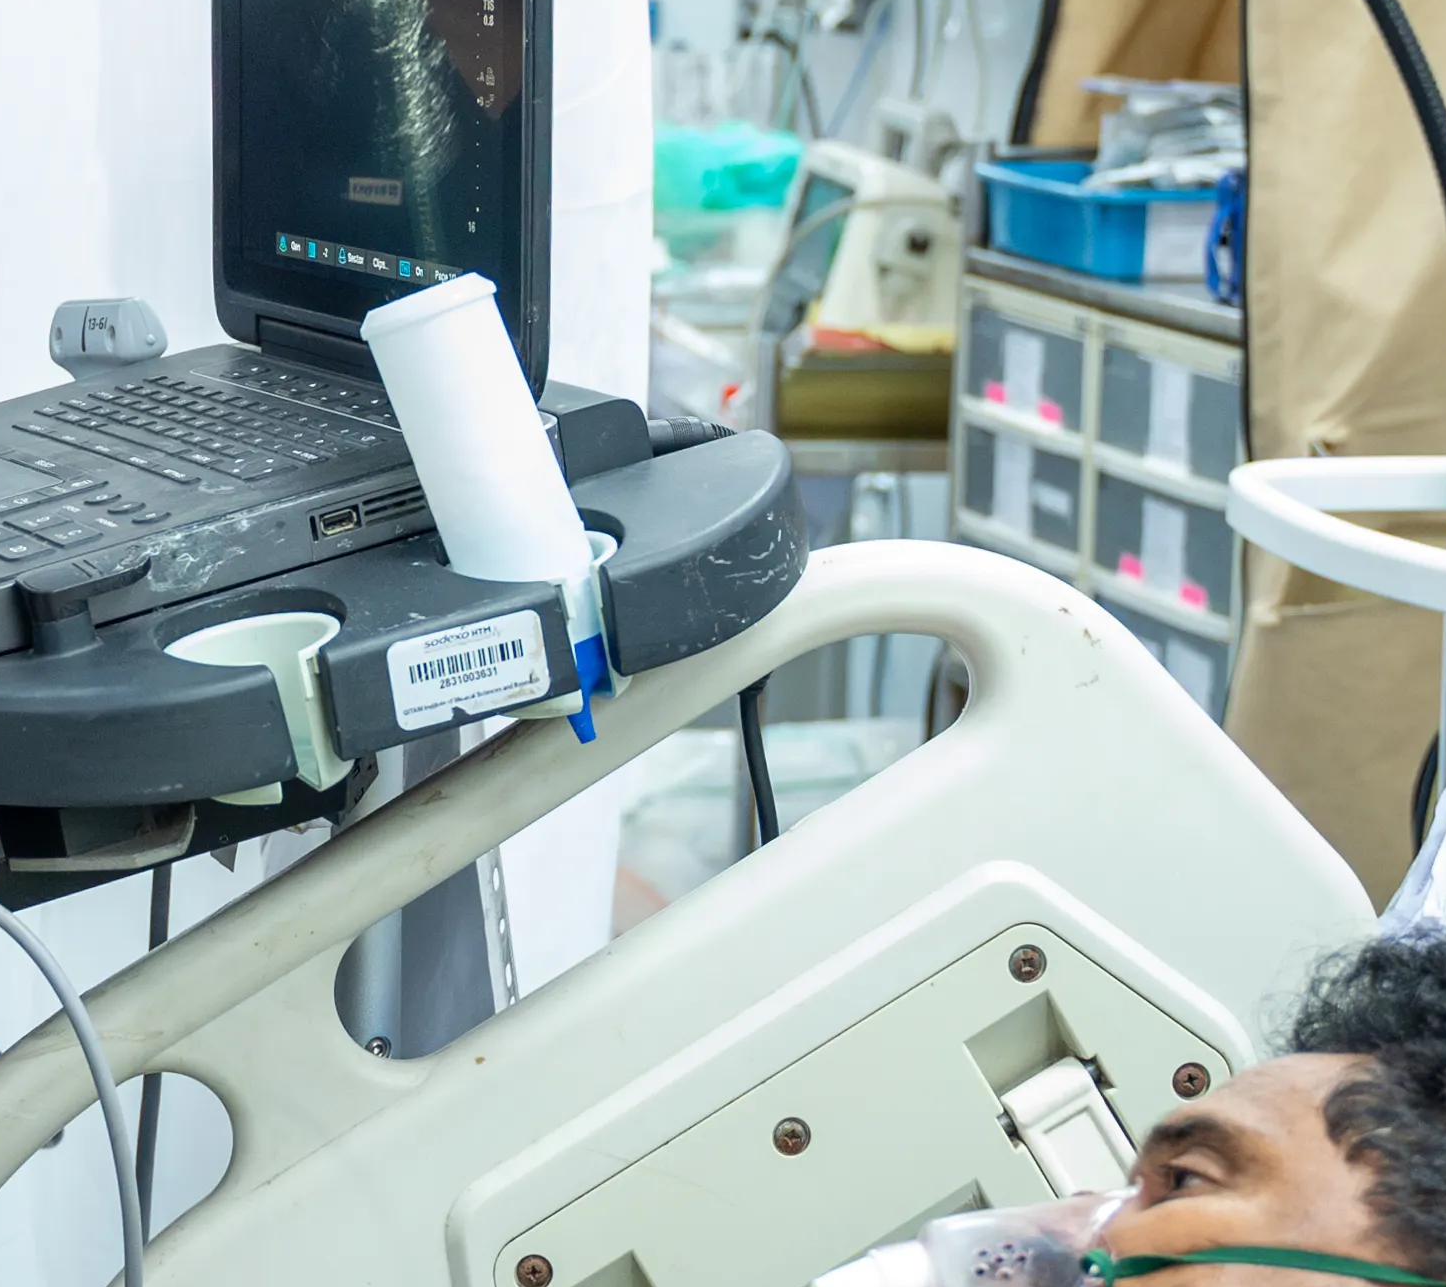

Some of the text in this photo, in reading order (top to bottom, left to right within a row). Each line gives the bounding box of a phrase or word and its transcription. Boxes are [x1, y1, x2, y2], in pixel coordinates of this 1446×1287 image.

[415, 266, 424, 277] On
[424, 625, 492, 648] sodexo HTM
[439, 666, 499, 689] 2831003631
